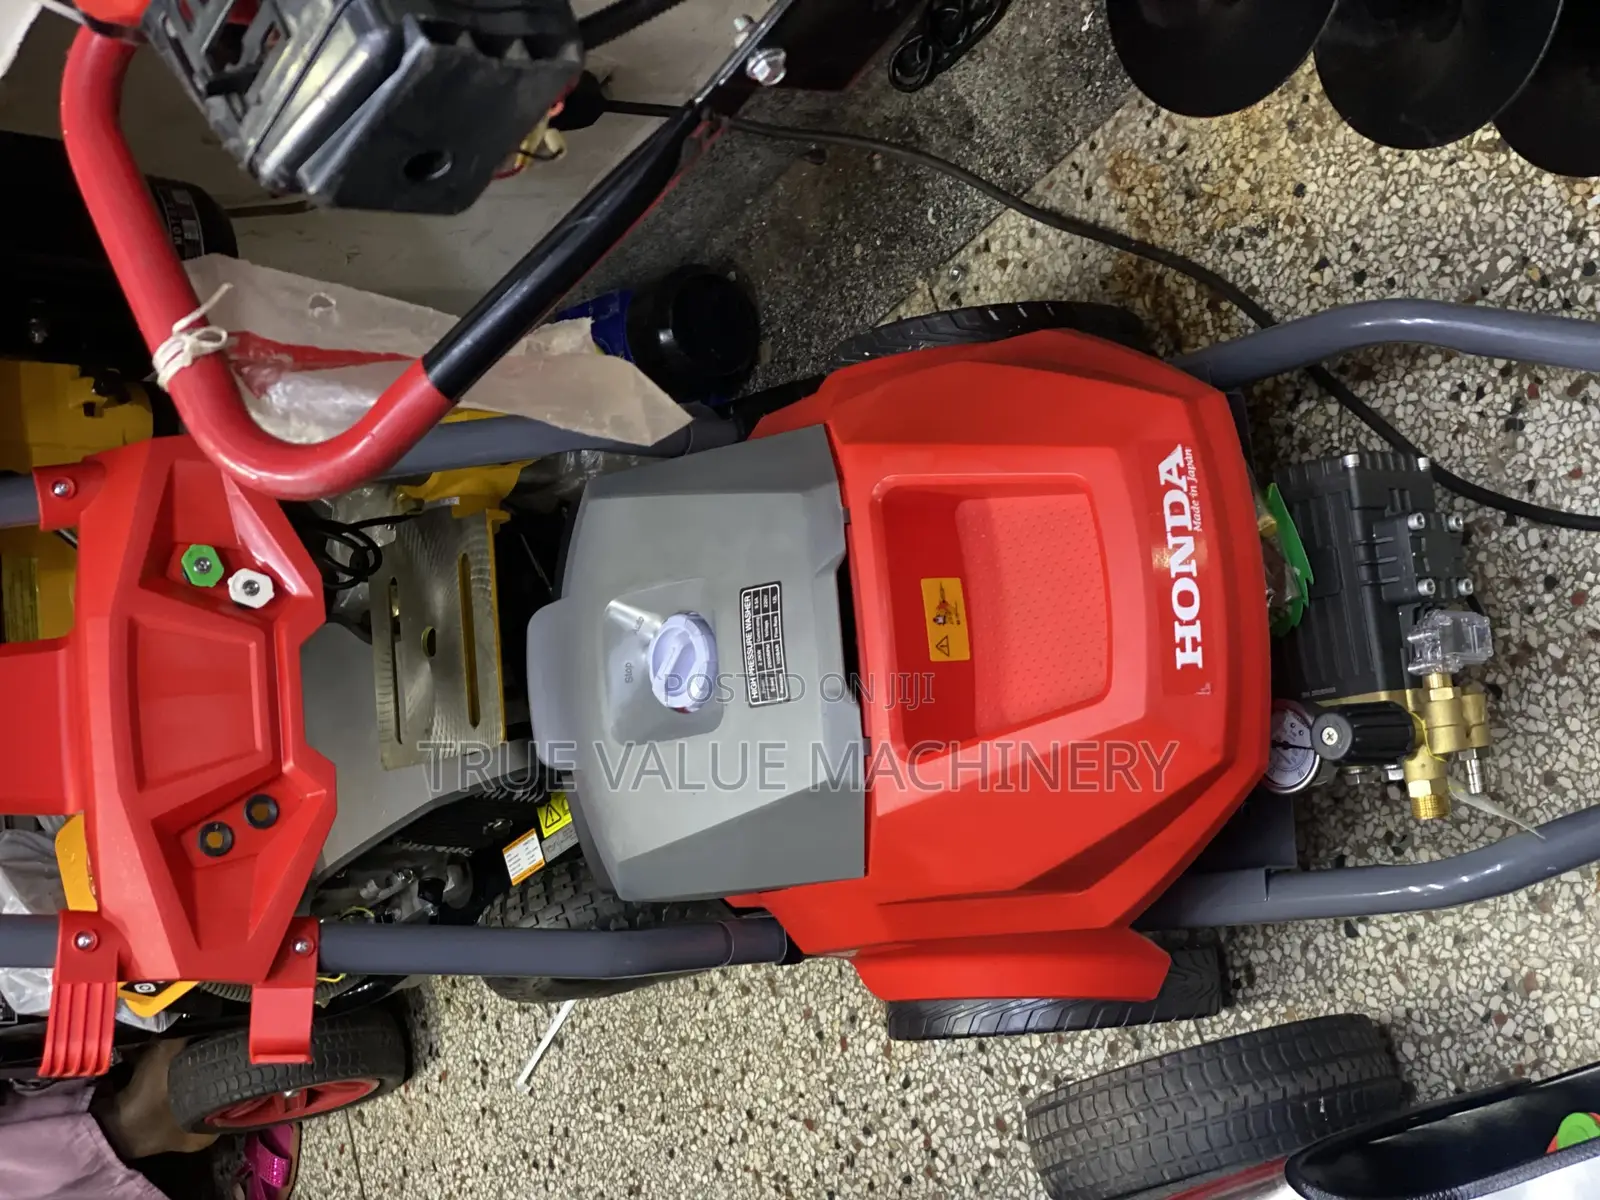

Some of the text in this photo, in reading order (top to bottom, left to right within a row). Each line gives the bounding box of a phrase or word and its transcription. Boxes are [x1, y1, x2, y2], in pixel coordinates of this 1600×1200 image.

[1184, 448, 1203, 532] Made in Japan
[1158, 444, 1203, 670] HONDA
[624, 662, 634, 684] Stop
[743, 595, 759, 699] HIGH PRESSURE WASHER
